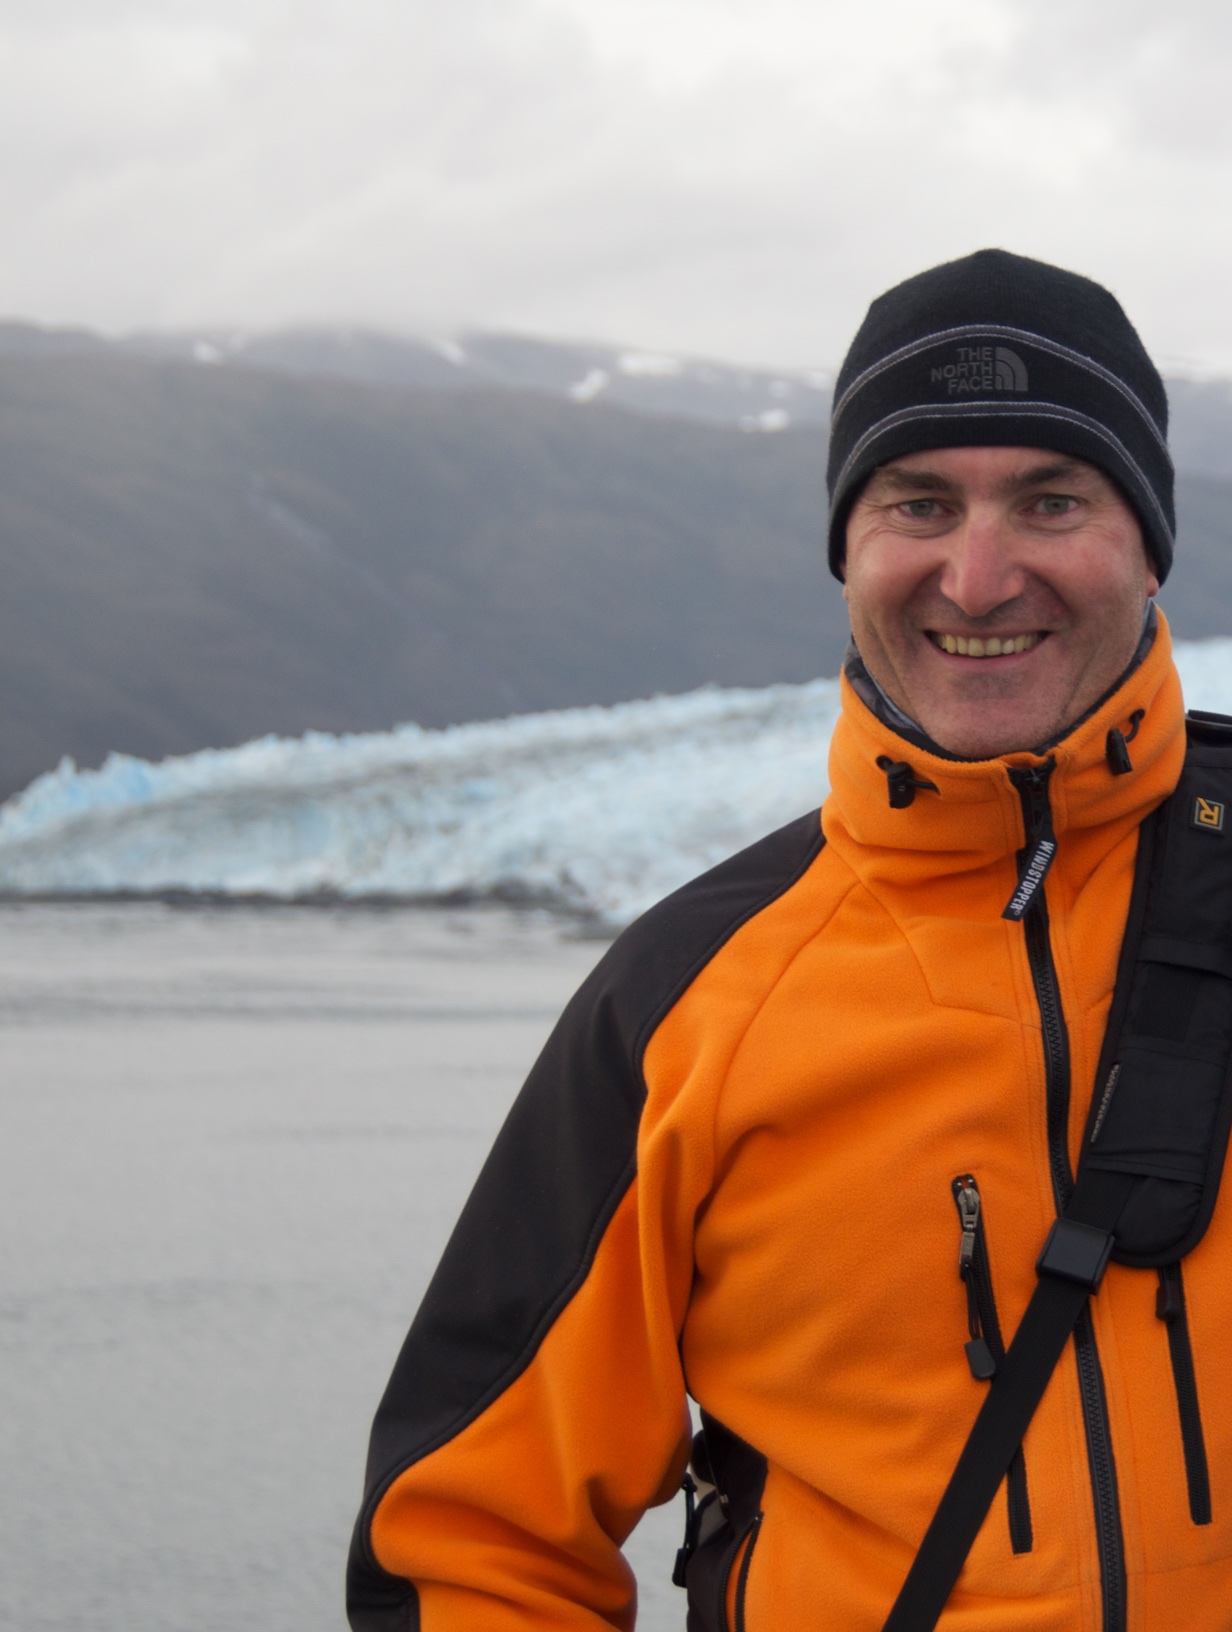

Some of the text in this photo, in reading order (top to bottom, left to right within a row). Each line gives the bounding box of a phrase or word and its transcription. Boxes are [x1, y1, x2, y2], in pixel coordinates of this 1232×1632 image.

[957, 347, 993, 361] THE
[931, 361, 993, 382] NORTH
[947, 376, 994, 395] FACE
